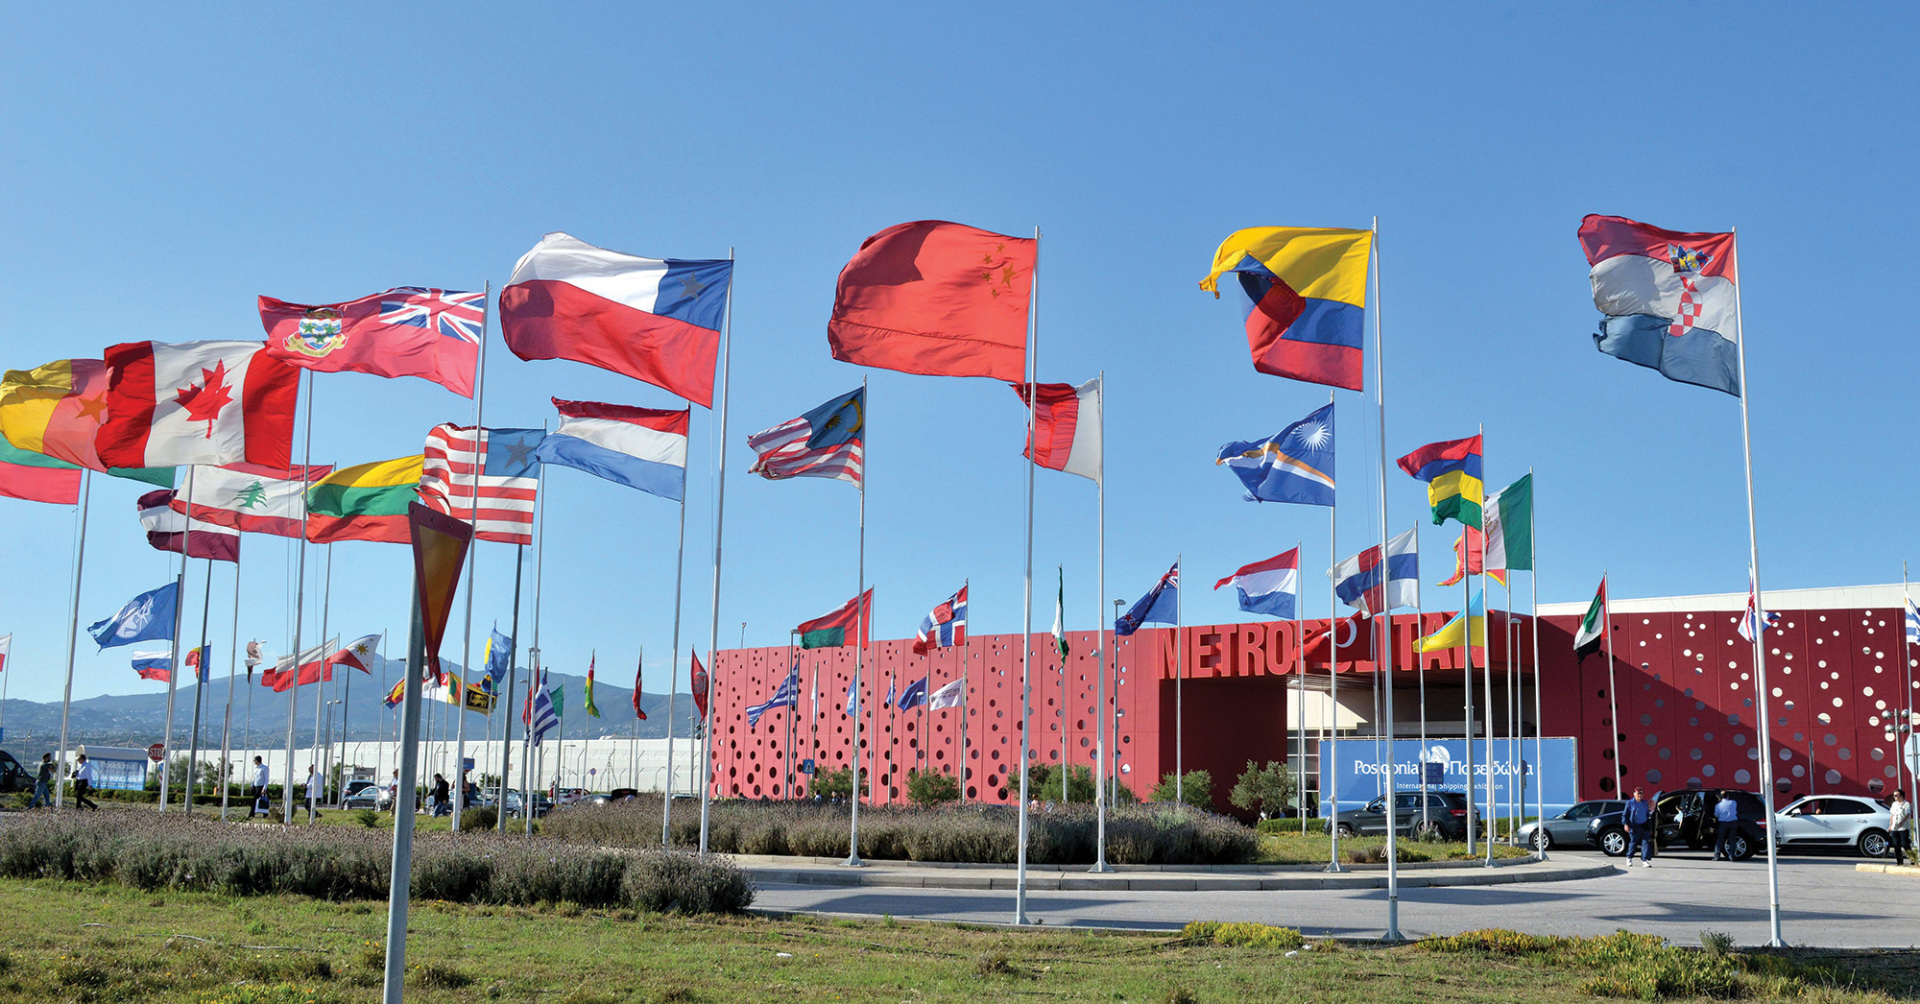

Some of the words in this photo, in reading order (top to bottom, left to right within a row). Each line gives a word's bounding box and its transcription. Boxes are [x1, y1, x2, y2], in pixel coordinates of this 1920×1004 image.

[1157, 609, 1486, 679] METROPITA
[149, 747, 165, 757] STO
[1355, 760, 1419, 775] Posdonia
[1450, 761, 1534, 775] Ποσεδώνα
